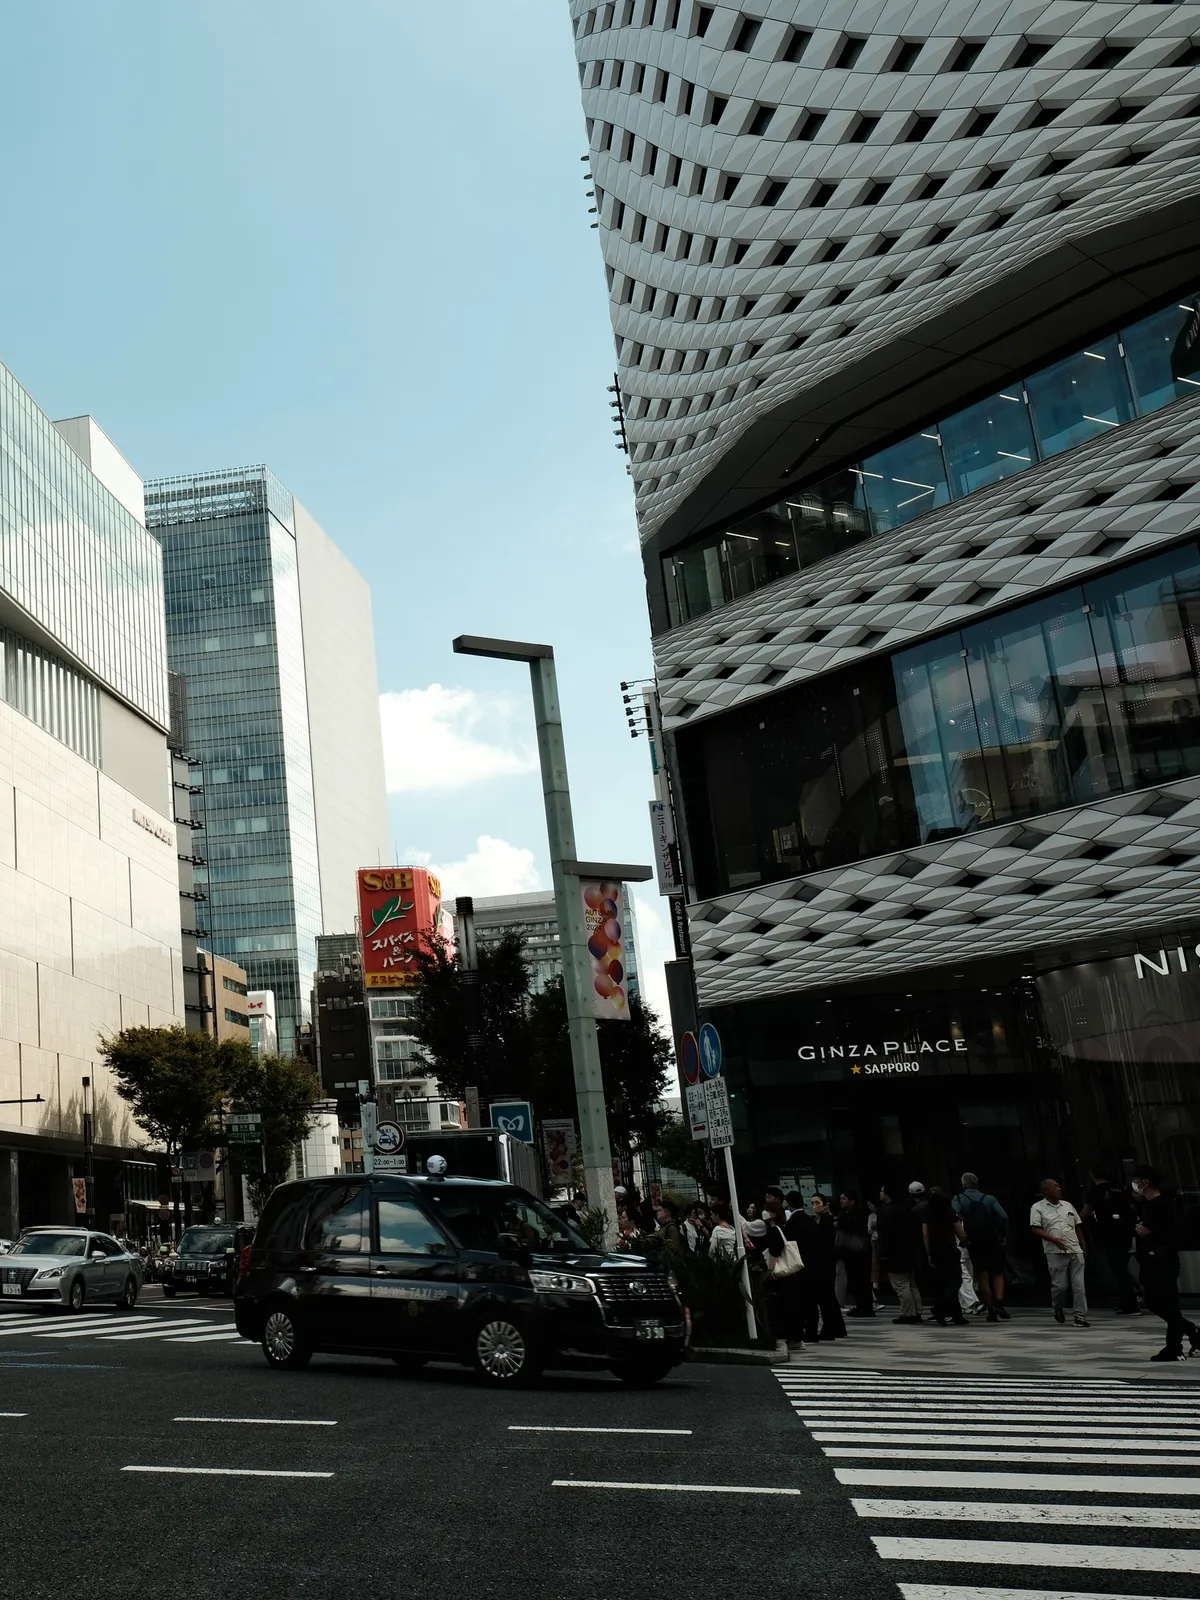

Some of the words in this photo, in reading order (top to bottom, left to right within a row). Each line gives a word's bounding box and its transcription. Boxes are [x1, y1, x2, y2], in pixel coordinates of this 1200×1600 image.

[363, 871, 414, 892] S&B
[585, 909, 615, 917] AUTUMN
[586, 916, 608, 924] GINZA
[372, 931, 415, 951] スパイス
[797, 1044, 878, 1061] GINZA
[882, 1038, 969, 1056] PLACE
[864, 1061, 920, 1075] SAPPORO
